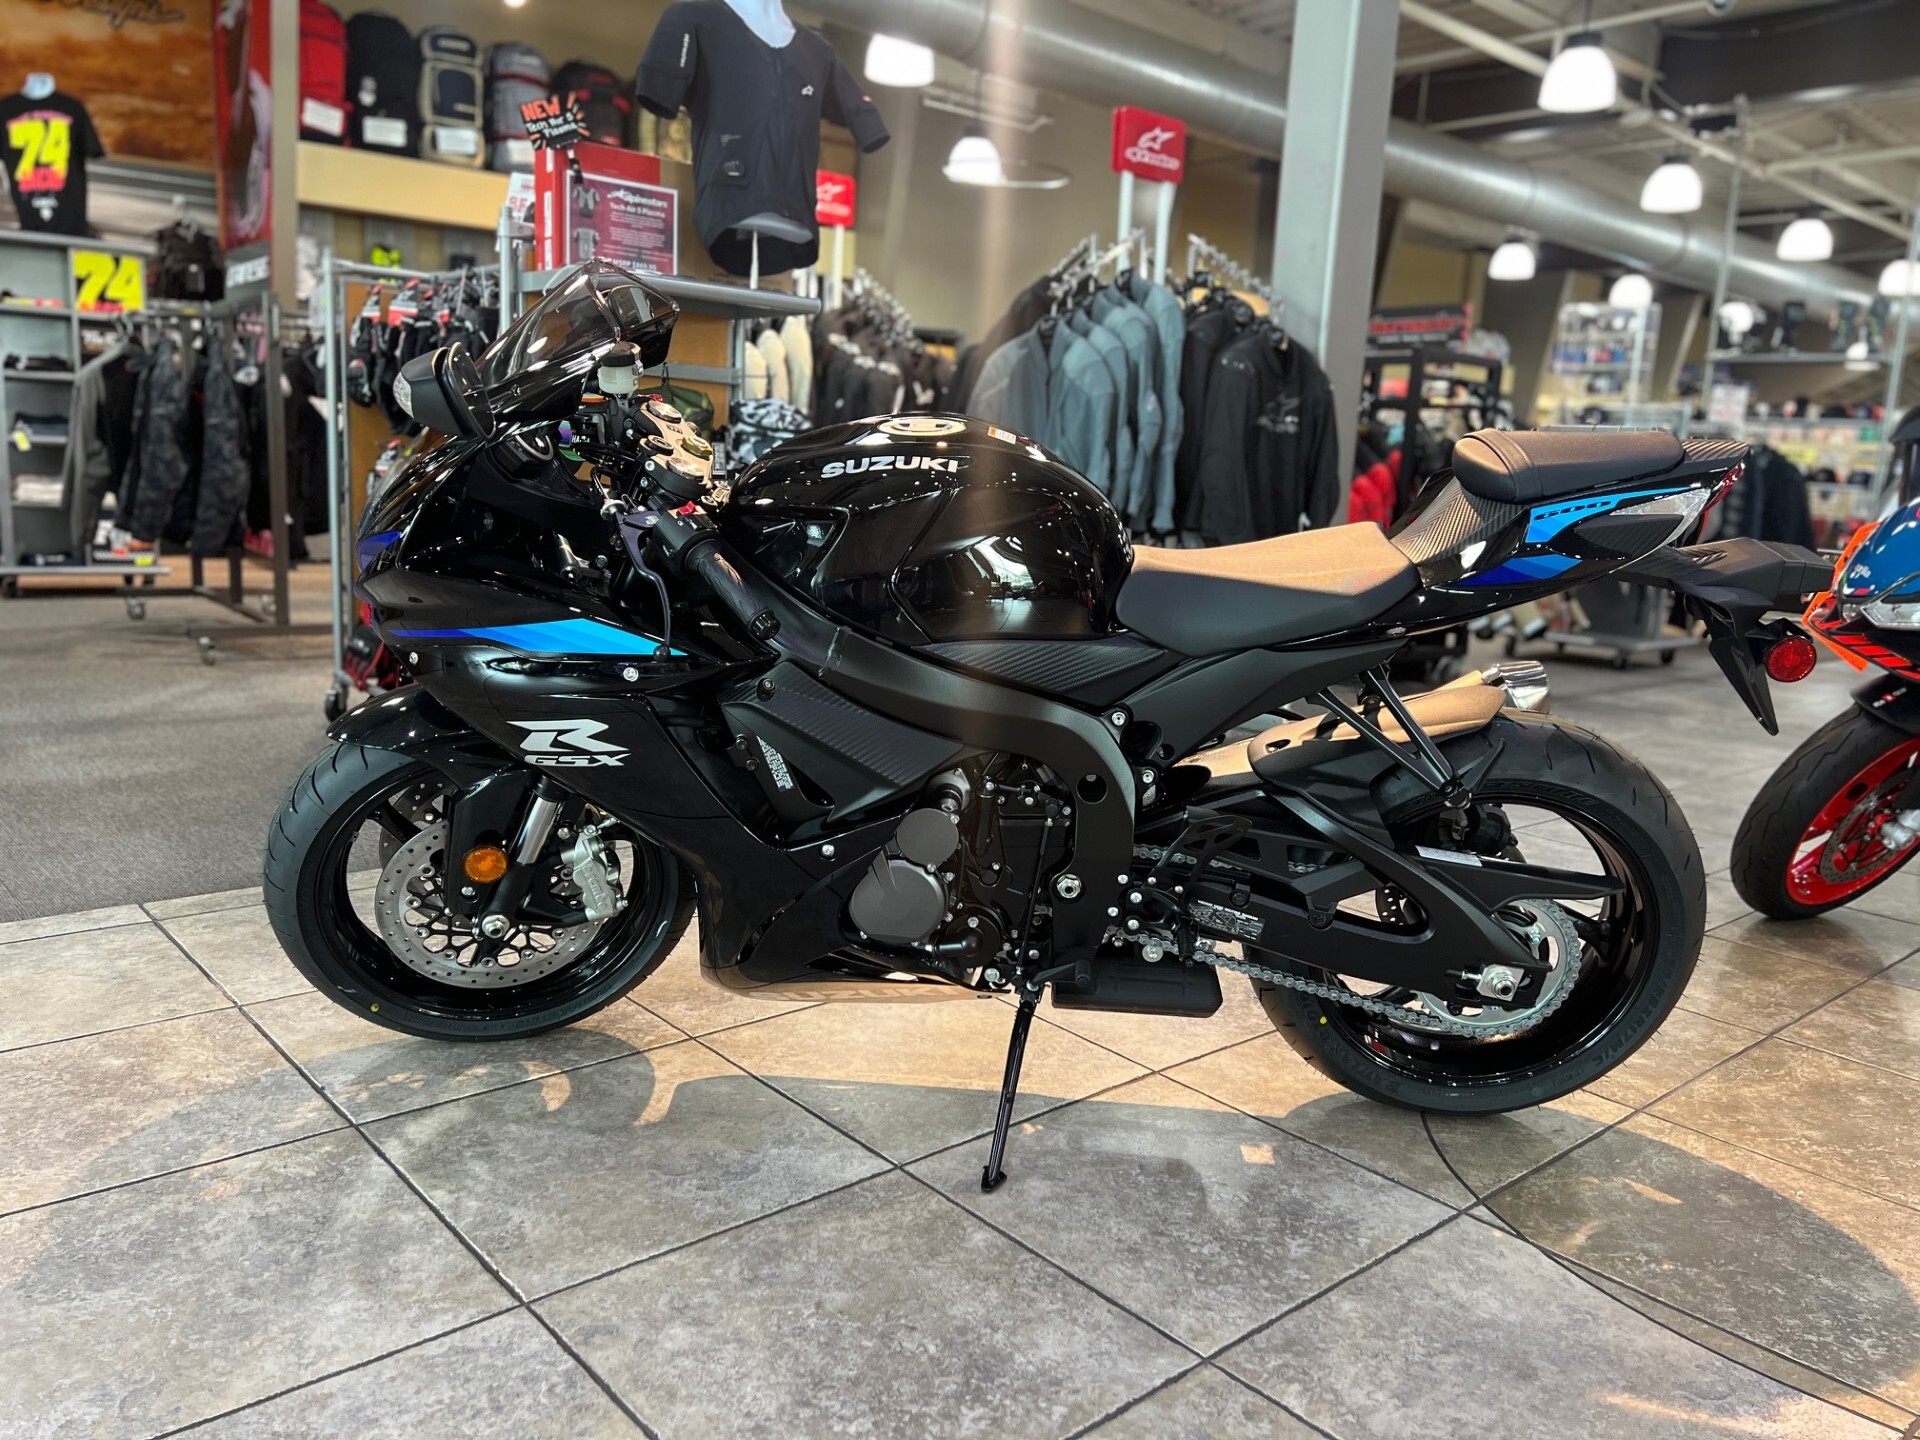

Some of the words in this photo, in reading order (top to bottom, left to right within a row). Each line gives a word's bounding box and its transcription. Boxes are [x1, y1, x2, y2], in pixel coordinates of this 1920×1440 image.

[521, 98, 561, 121] NEW
[526, 118, 548, 133] Tech
[542, 122, 578, 139] Plasma
[9, 116, 70, 182] 74
[642, 208, 666, 219] Plasma
[74, 252, 143, 312] 74
[820, 455, 959, 479] SUZUKI
[1533, 500, 1612, 521] 600
[506, 718, 630, 753] R
[523, 753, 632, 768] GSX
[748, 987, 960, 1001] SUZUKI
